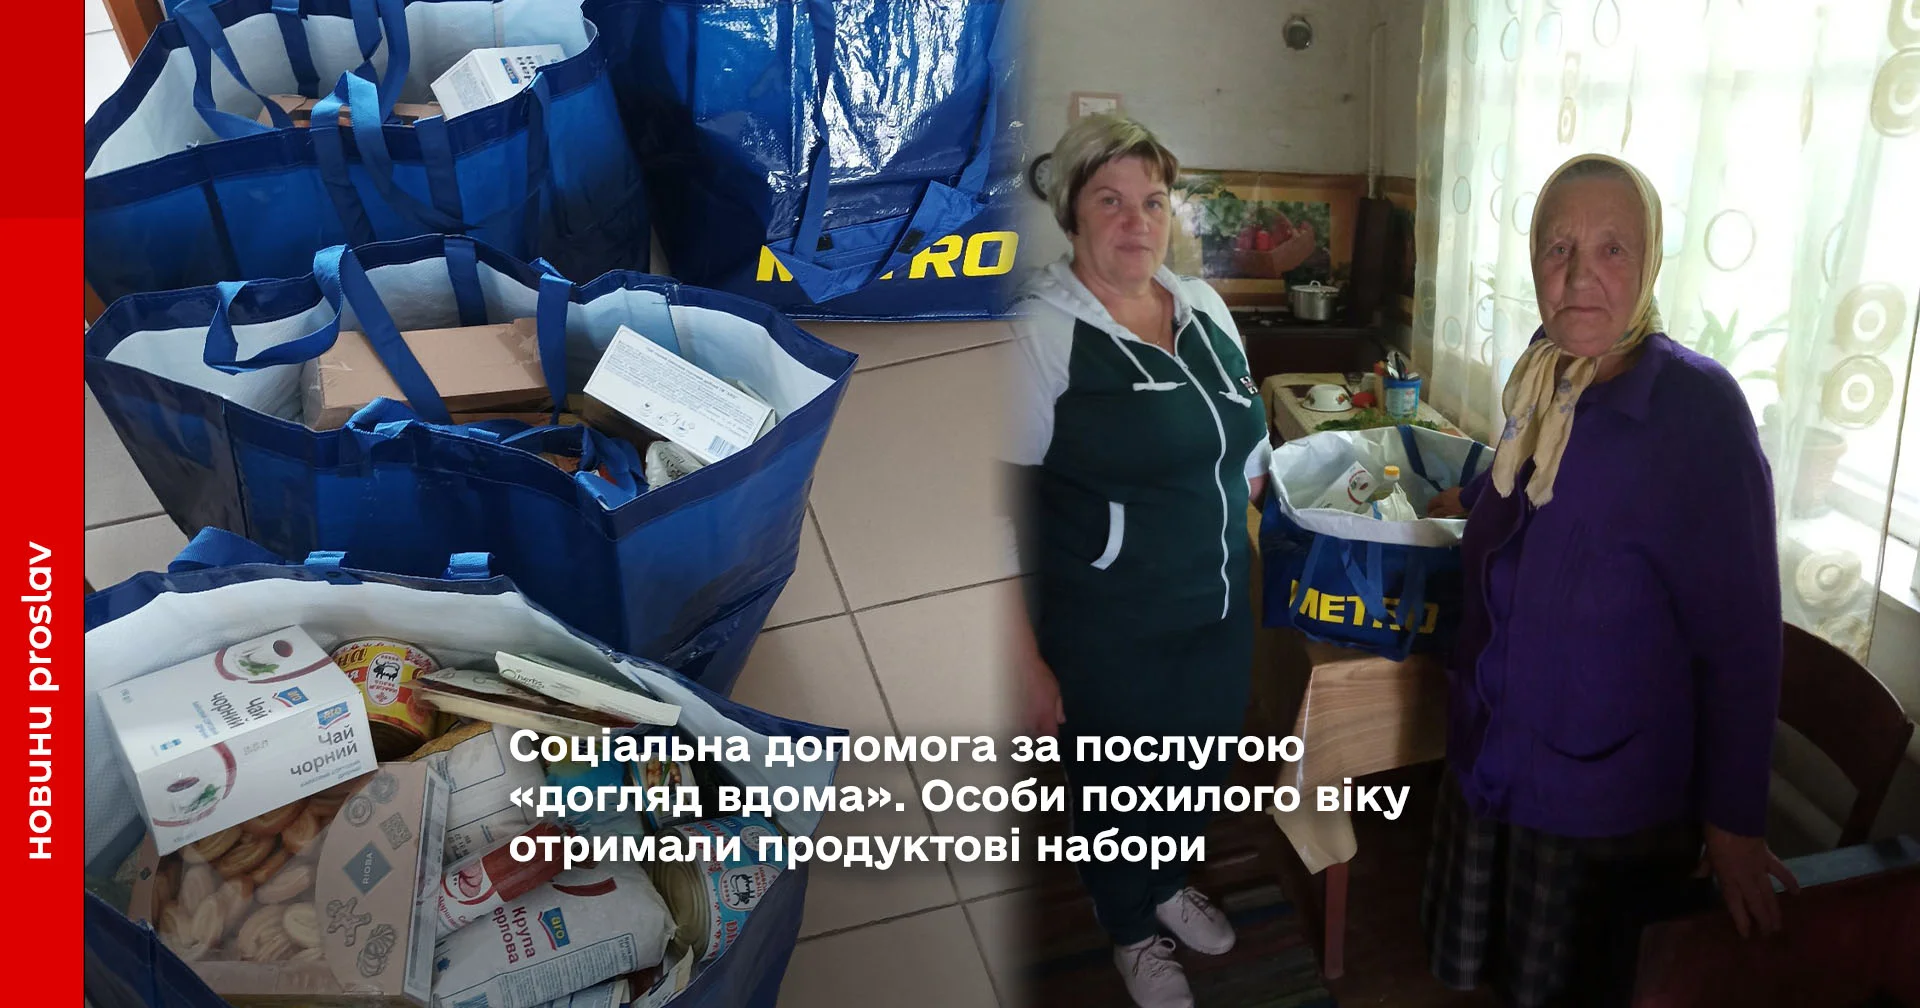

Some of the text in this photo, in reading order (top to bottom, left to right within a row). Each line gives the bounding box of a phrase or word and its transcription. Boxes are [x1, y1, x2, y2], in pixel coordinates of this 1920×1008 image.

[210, 691, 248, 729] чорний
[246, 697, 272, 720] Чай
[318, 724, 354, 745] Чай
[290, 740, 358, 775] чорний
[363, 852, 373, 884] RIOBA
[492, 906, 519, 964] ерлова
[512, 906, 535, 958] Крупа
[551, 916, 565, 940] aro
